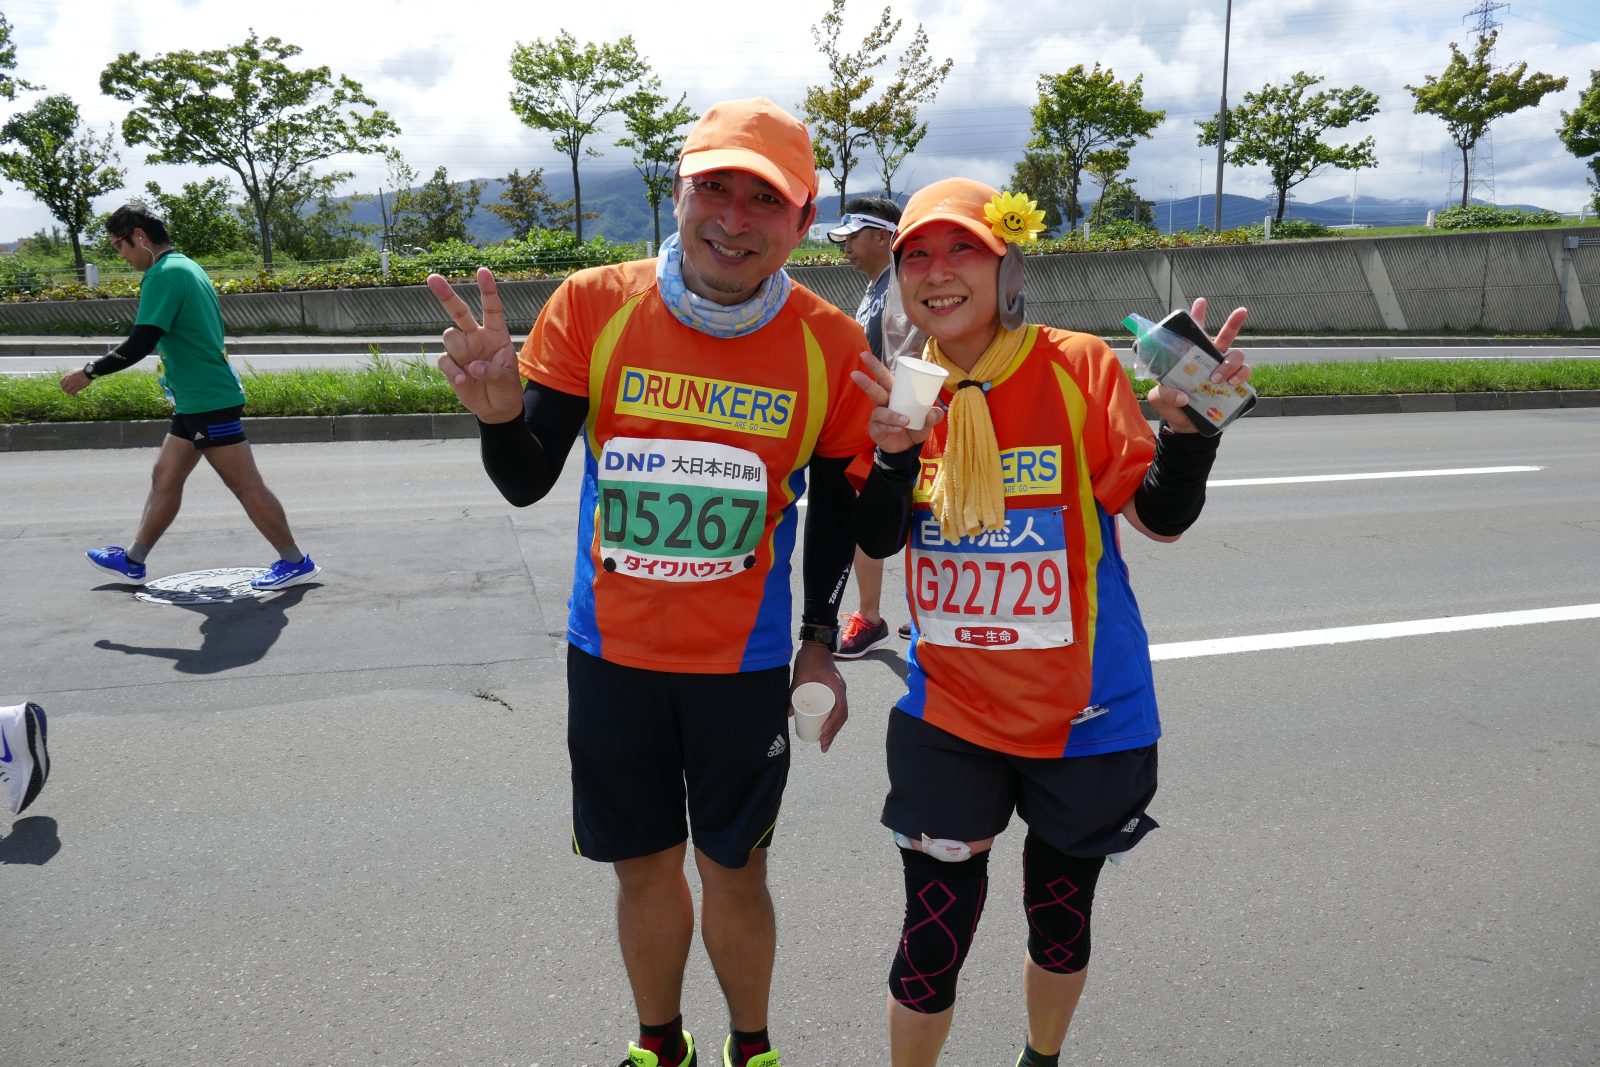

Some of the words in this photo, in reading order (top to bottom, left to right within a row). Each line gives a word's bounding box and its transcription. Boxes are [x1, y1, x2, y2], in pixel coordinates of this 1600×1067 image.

[621, 370, 792, 426] DRUNKERS
[734, 421, 747, 430] ARE
[750, 423, 758, 431] GO
[604, 451, 666, 473] DNP
[671, 456, 761, 482] 大日本印刷
[1019, 484, 1028, 493] GO
[603, 488, 760, 551] D5267
[921, 516, 1045, 547] 白恋人
[623, 554, 734, 578] ダイワハウス
[916, 556, 1062, 616] G22729
[960, 628, 1012, 643] 第一生命
